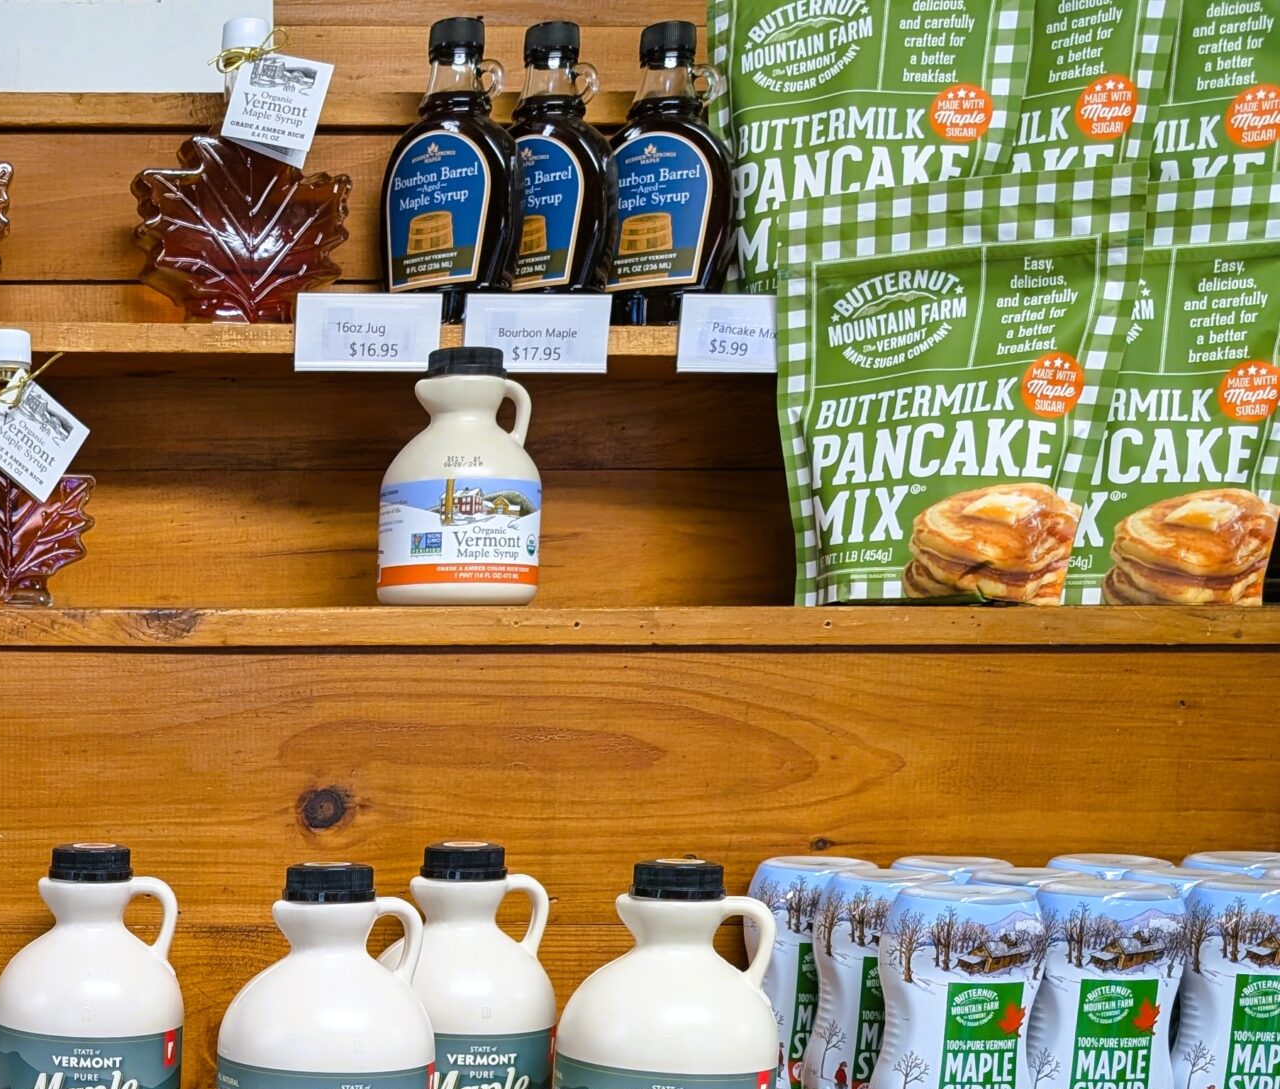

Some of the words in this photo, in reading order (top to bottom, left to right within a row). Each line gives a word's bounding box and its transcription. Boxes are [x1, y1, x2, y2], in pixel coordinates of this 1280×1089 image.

[243, 93, 306, 118] Vermont
[244, 110, 275, 123] Maple
[279, 114, 302, 128] Syrup
[394, 172, 436, 191] Bourbon
[440, 162, 478, 180] Barrel
[399, 195, 430, 213] Maple
[433, 189, 468, 207] Syrup
[1023, 257, 1053, 273] Easy,
[1009, 274, 1066, 291] delicious,
[832, 269, 960, 317] BUTTERNUT
[995, 294, 1018, 309] and
[1022, 290, 1077, 308] carefully
[827, 309, 916, 347] MOUNTAIN
[920, 296, 967, 321] FARM
[1000, 309, 1044, 325] crafted
[1048, 307, 1066, 321] for
[335, 322, 361, 334] 16oz
[366, 322, 385, 337] Jug
[499, 328, 542, 339] Bourbon
[546, 328, 577, 341] Maple
[712, 322, 755, 339] Pancake
[758, 327, 777, 339] Mix
[1005, 329, 1012, 339] a
[1016, 323, 1053, 339] better
[708, 340, 746, 356] $5.99
[841, 347, 872, 369] MAPLE
[872, 354, 904, 369] SUGAR
[906, 322, 952, 359] COMPANY
[875, 328, 927, 352] VERMONT
[995, 338, 1057, 356] breakfast.
[349, 341, 398, 358] $16.95
[512, 346, 560, 362] $17.95
[1031, 368, 1053, 381] MADE
[1056, 369, 1075, 383] WITH
[1025, 380, 1074, 398] Maple
[814, 376, 1017, 430] BUTTERMILK
[1033, 398, 1065, 413] SUGAR!
[811, 418, 1055, 490] PANCAKE
[812, 484, 908, 545] MIX
[452, 531, 520, 548] Vermont
[472, 526, 506, 536] Organic
[457, 548, 489, 560] Maple
[493, 549, 519, 561] Syrup
[845, 551, 857, 562] LB
[945, 1040, 965, 1050] 100%
[967, 1040, 982, 1050] PURE
[984, 1039, 1014, 1050] VERMONT
[52, 1056, 122, 1069] VERMONT
[943, 1050, 1012, 1083] MAPLE
[74, 1073, 99, 1082] PURE
